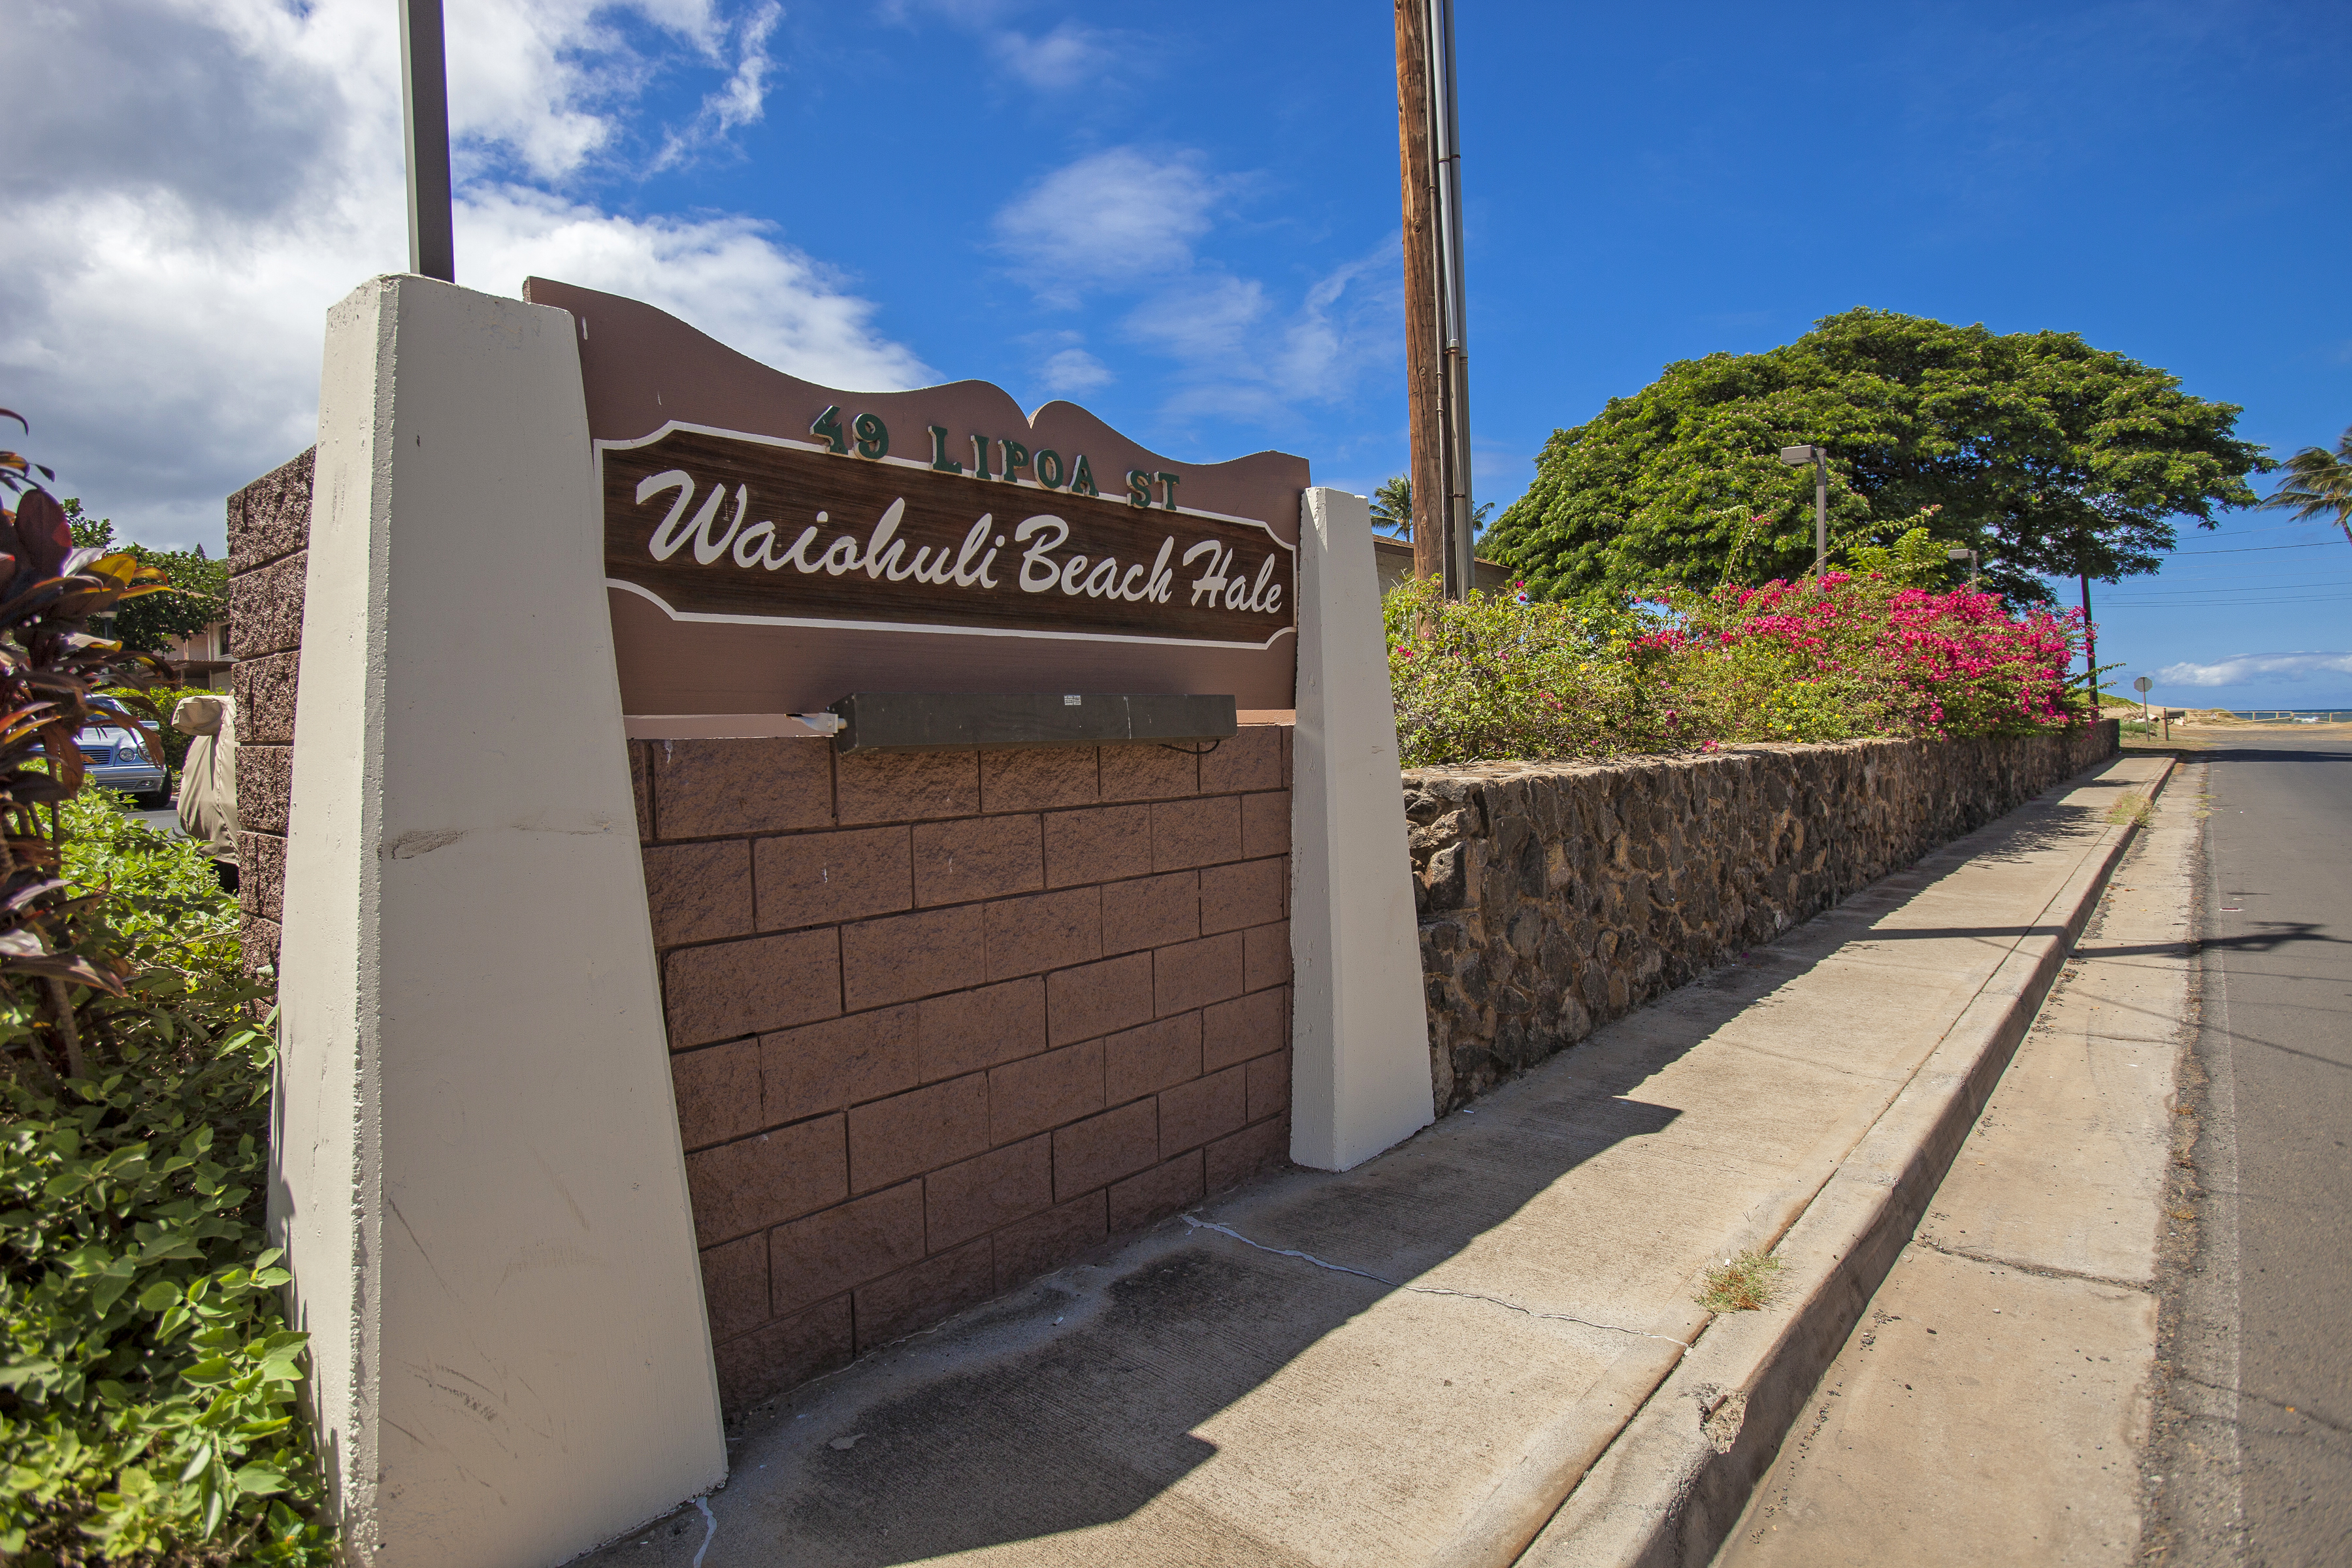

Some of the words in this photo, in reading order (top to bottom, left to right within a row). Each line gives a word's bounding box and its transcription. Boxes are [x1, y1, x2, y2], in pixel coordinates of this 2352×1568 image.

[809, 405, 889, 461] 49
[928, 425, 1100, 498] LIPOA
[1126, 469, 1180, 511] ST
[636, 469, 1005, 589] Waiohuli
[1015, 514, 1175, 604] Beach
[1183, 540, 1282, 613] Hale
